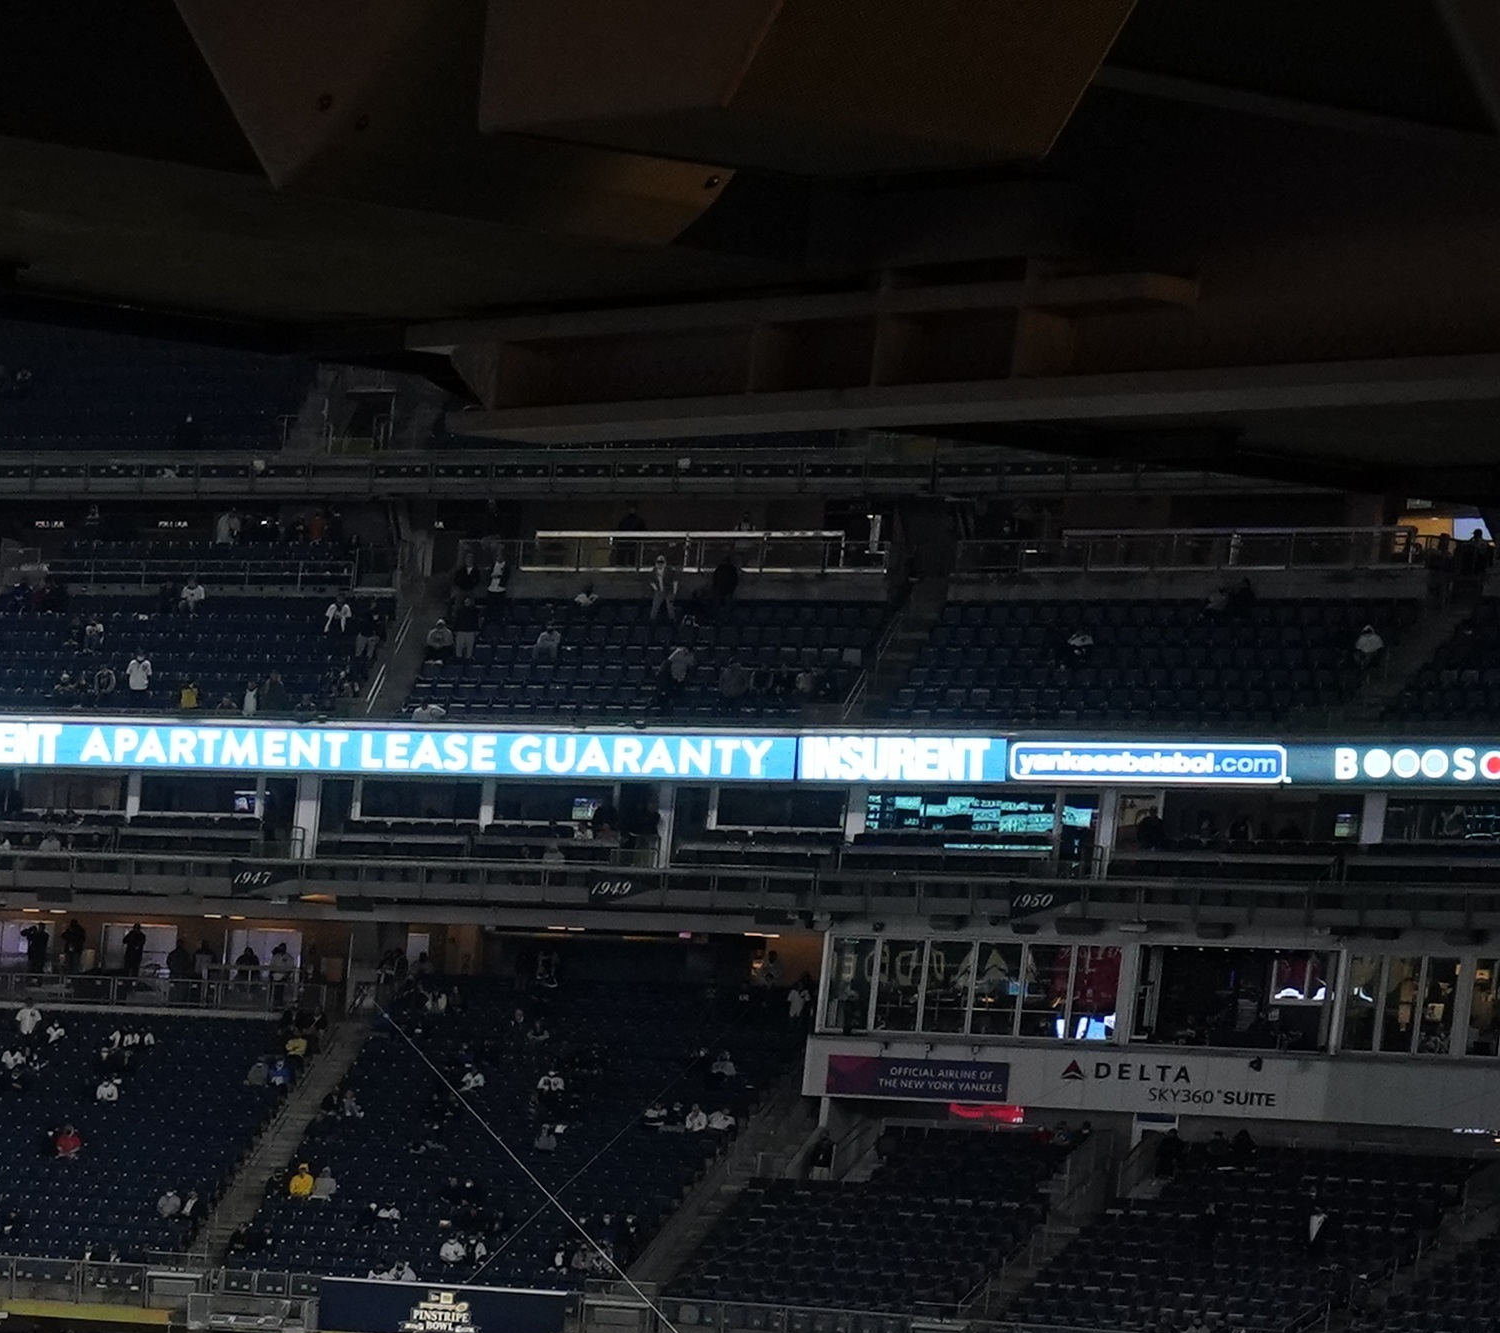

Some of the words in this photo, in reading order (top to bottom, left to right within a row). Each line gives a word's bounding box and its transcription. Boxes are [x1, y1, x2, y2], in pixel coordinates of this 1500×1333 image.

[79, 727, 349, 767] APARTMENT
[361, 733, 496, 771] LEASE
[509, 736, 773, 776] GUARANTY
[800, 737, 991, 780] INSURENT
[889, 1066, 935, 1078] OFFICIAL
[937, 1068, 979, 1080] AIRLINE
[980, 1069, 994, 1081] OF
[1094, 1062, 1191, 1085] DELTA
[879, 1077, 899, 1089] THE
[900, 1079, 925, 1090] NEW
[928, 1079, 955, 1091] YORK
[958, 1081, 1003, 1093] YANKEES
[1223, 1091, 1277, 1107] SUITE
[412, 1309, 470, 1323] PINSTRIPE
[425, 1320, 454, 1332] BOWL
